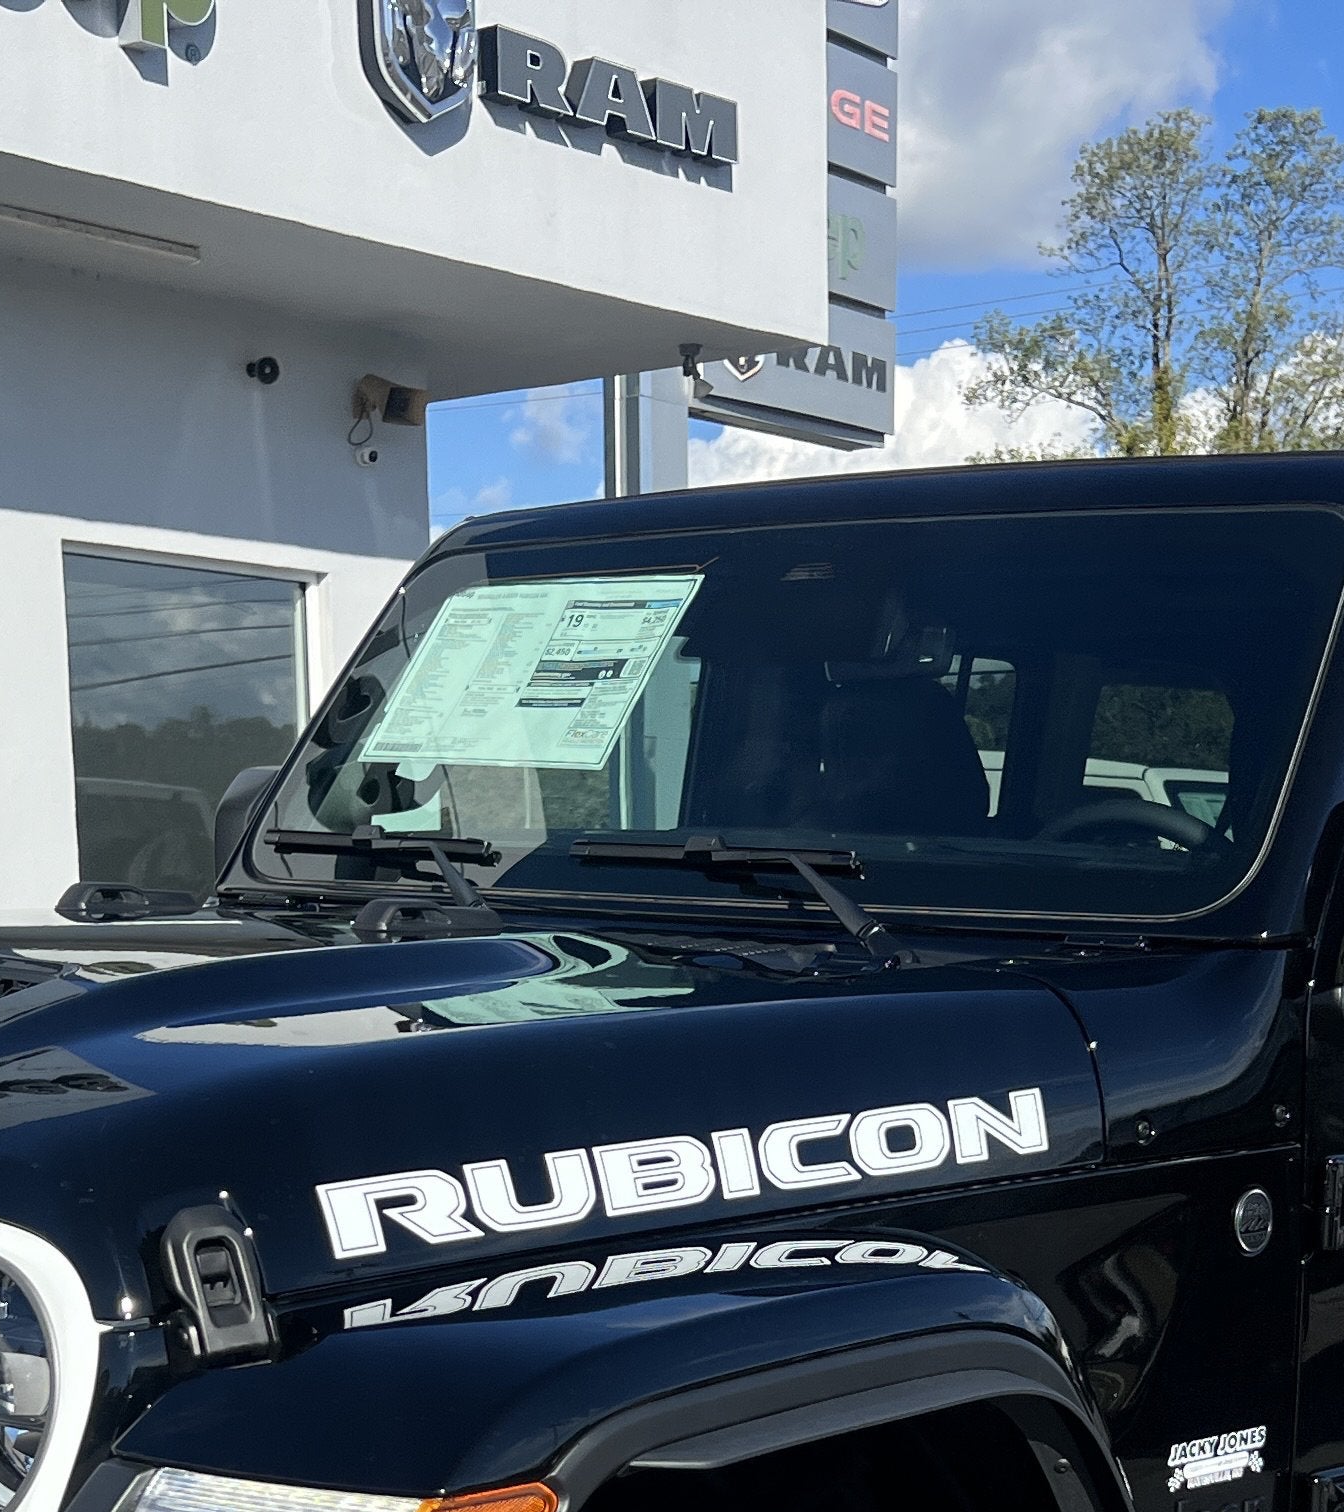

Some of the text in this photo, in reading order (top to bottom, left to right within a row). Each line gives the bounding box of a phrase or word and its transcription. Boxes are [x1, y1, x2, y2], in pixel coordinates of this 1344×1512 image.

[479, 23, 739, 165] RAM
[314, 1086, 1051, 1260] RUBICON
[1168, 1436, 1219, 1467] JACKY
[1217, 1425, 1267, 1455] JONES
